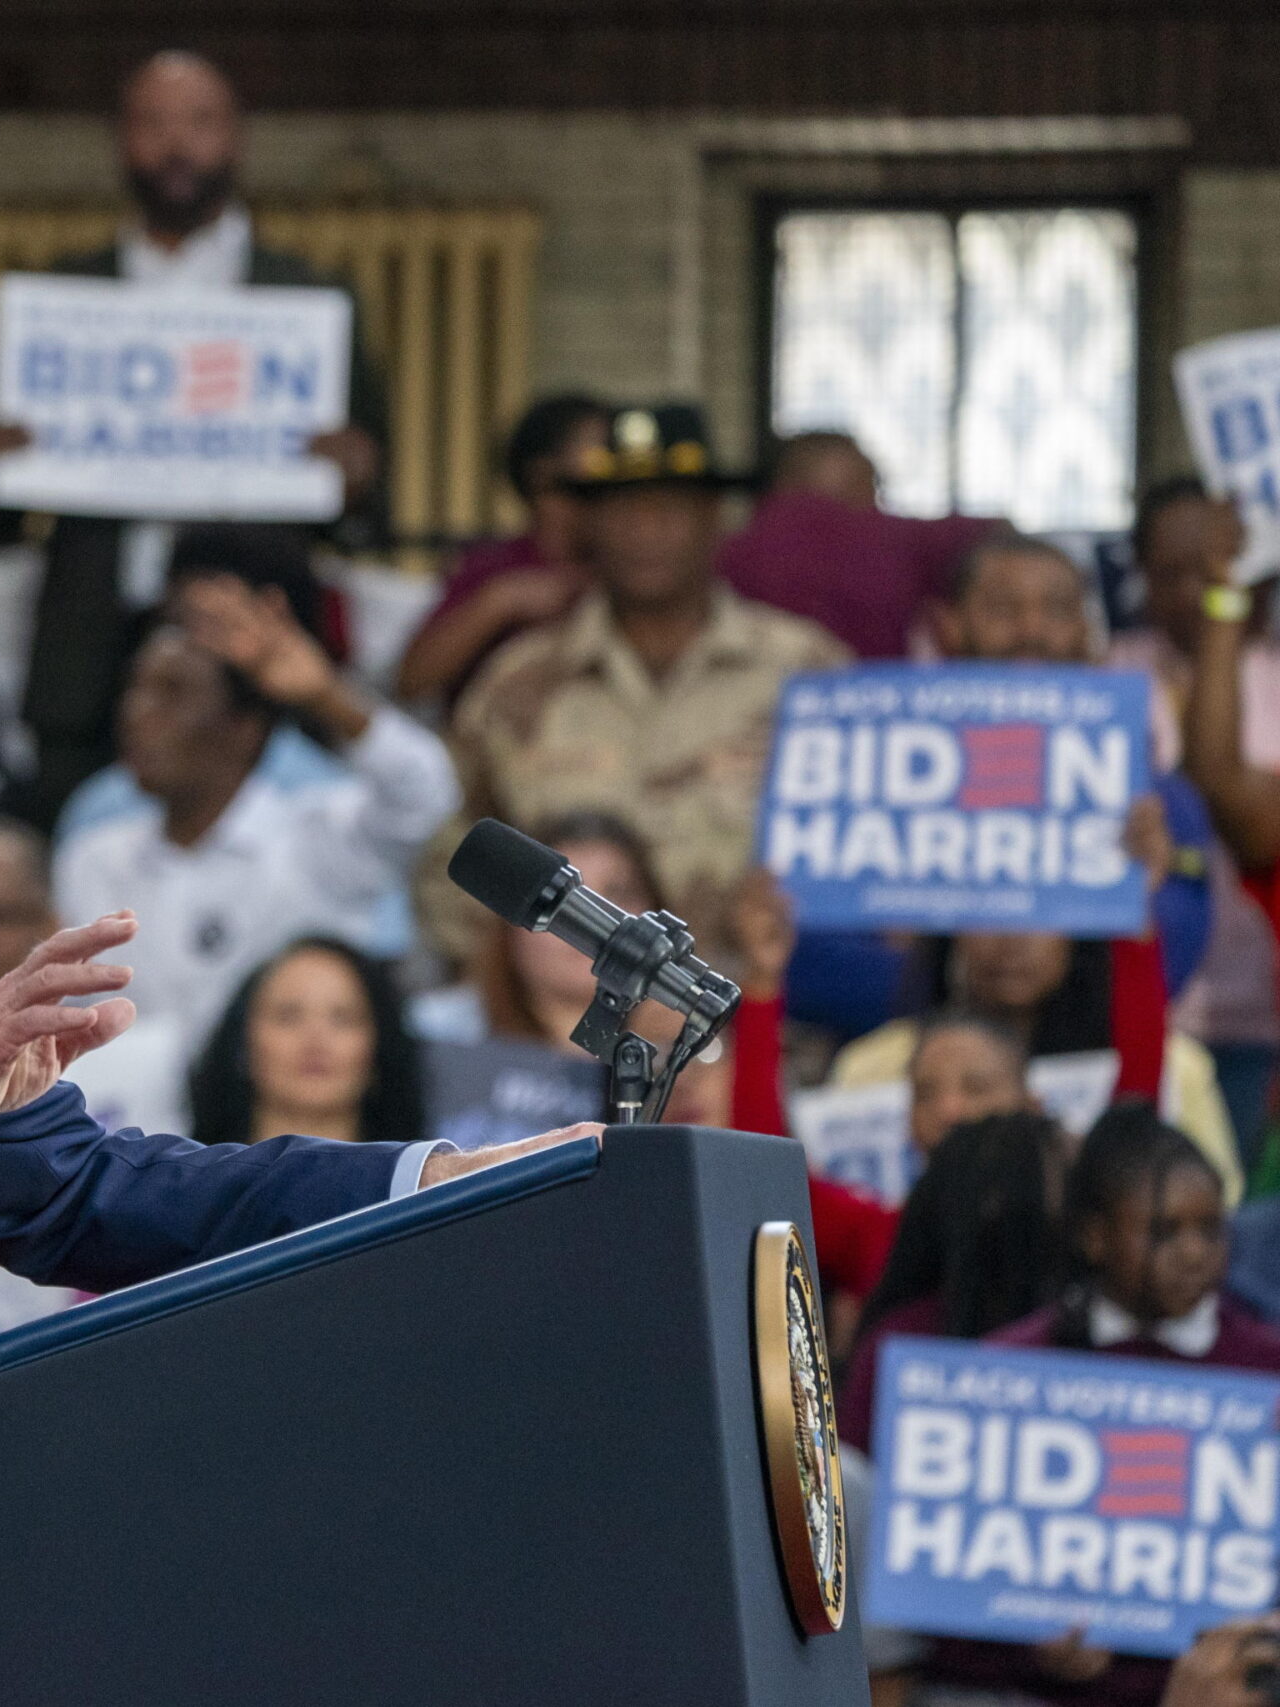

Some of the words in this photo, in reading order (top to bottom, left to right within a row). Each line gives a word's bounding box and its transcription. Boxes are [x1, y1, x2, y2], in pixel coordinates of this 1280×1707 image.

[21, 337, 318, 415] BIDEN
[776, 722, 1131, 811] BIDEN
[766, 808, 1129, 887] HARRIS
[896, 1361, 1039, 1410] BLACK
[1044, 1375, 1214, 1426] VOTERS
[894, 1405, 1280, 1529] BIDEN
[886, 1502, 1280, 1609] HARRIS
